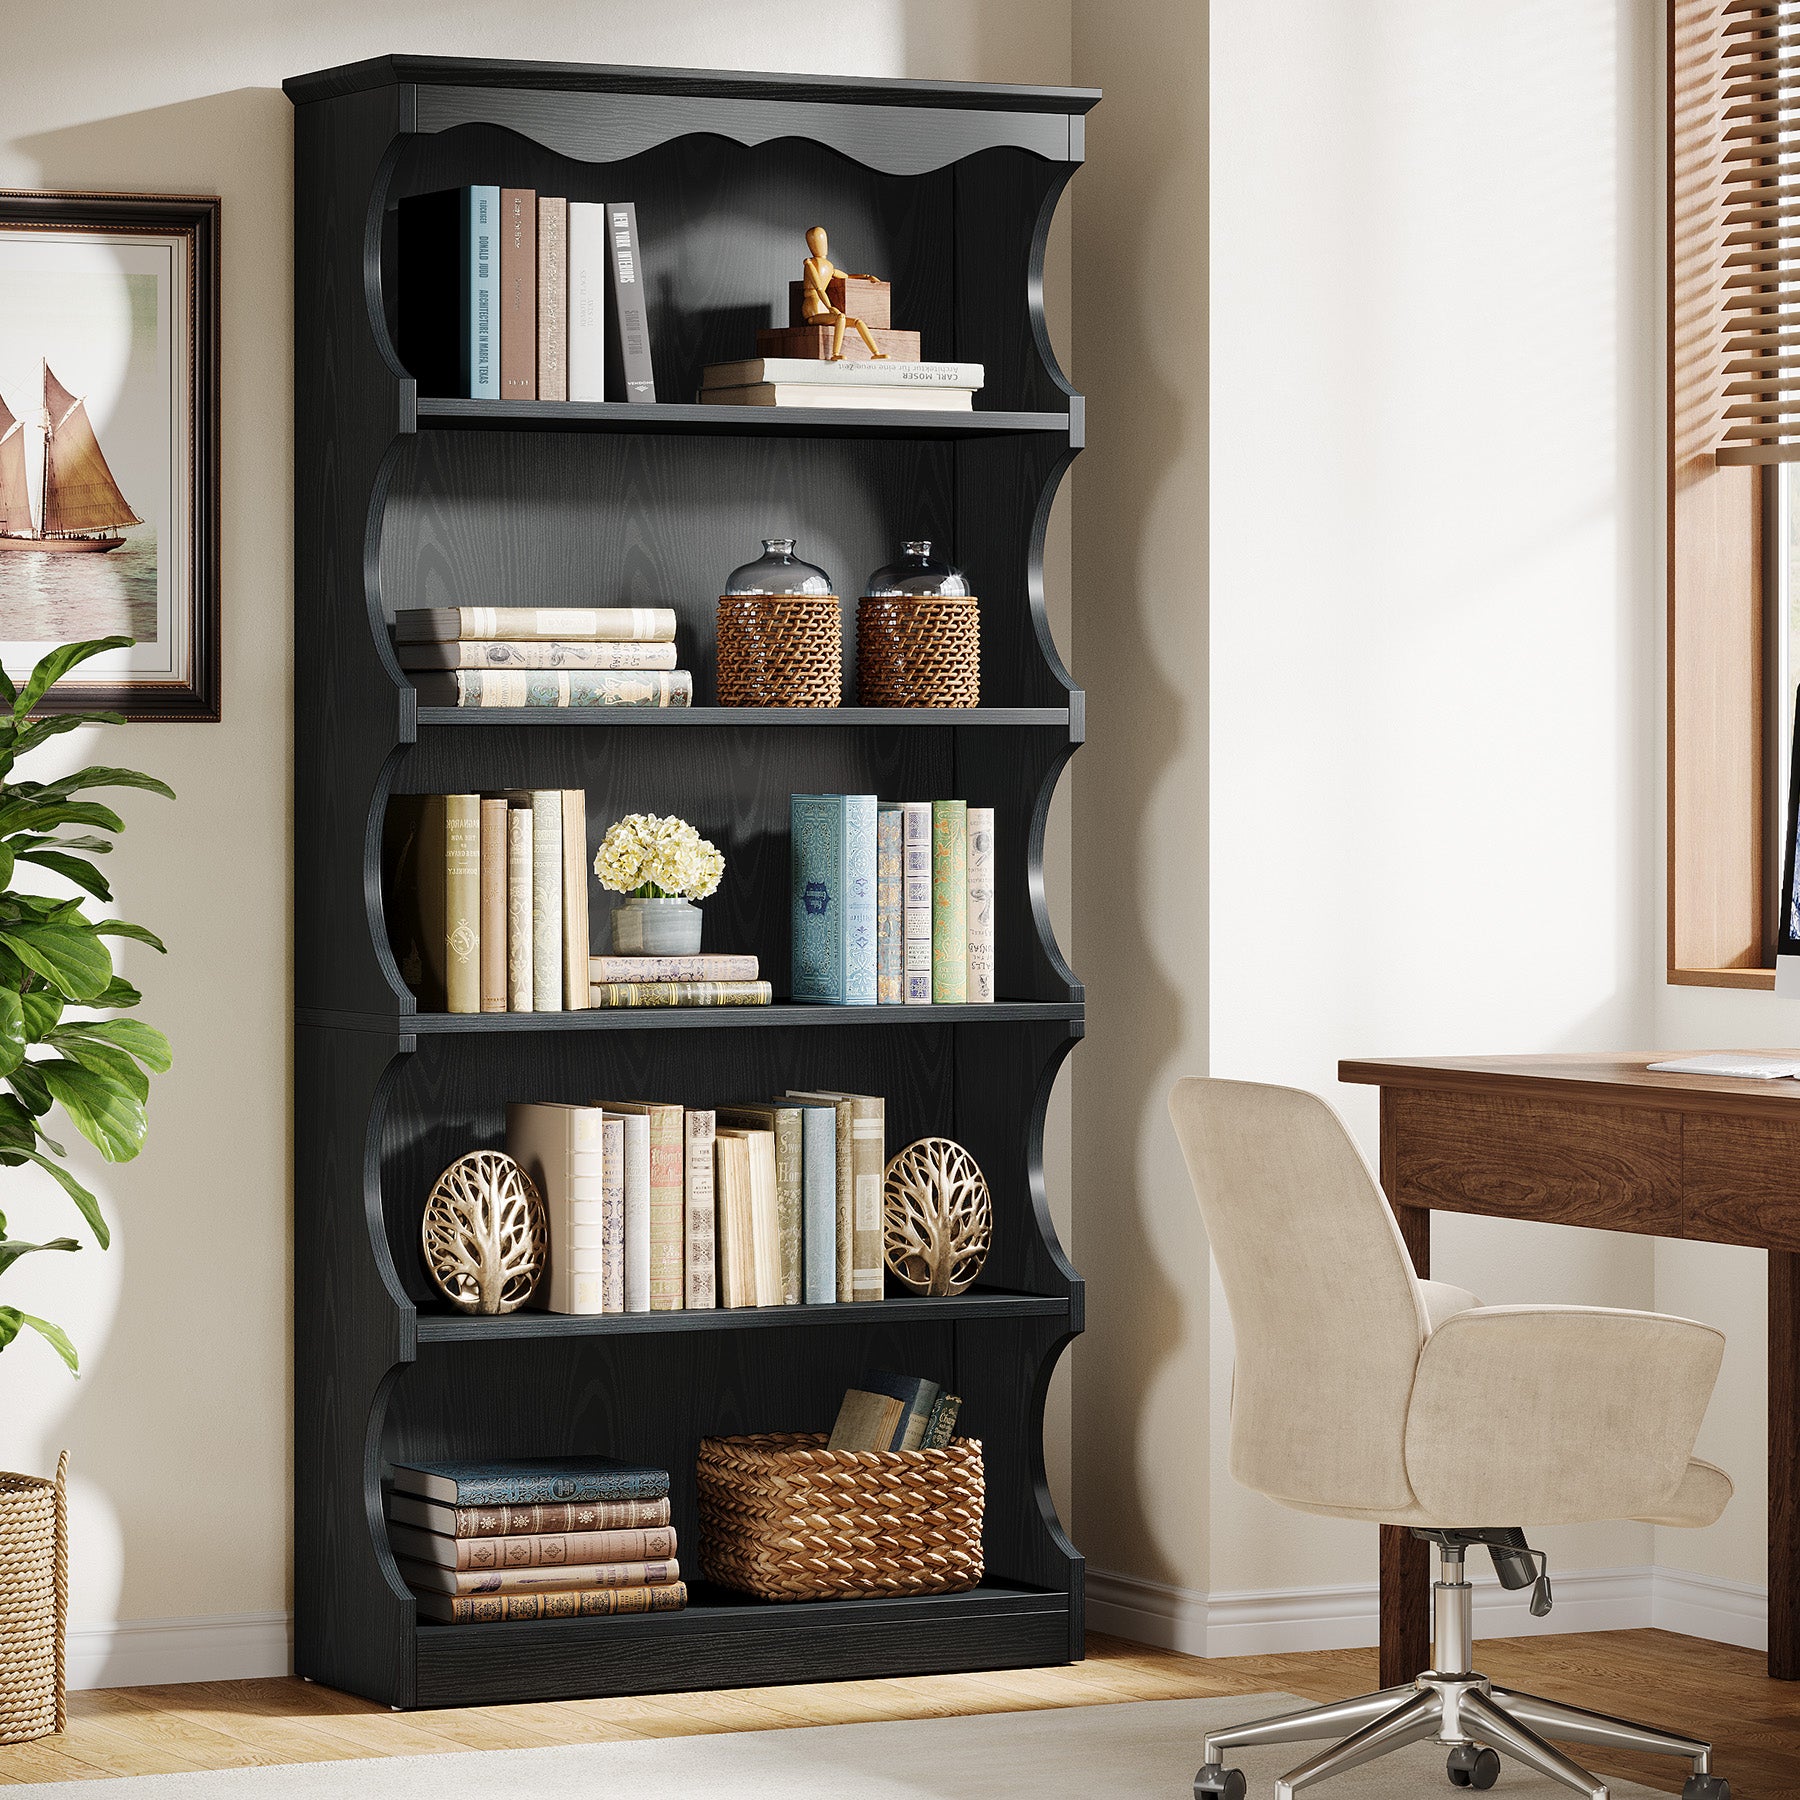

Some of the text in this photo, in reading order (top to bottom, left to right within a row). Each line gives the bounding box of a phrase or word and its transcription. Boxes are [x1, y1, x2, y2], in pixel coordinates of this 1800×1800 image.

[613, 212, 635, 284] NEW YORK INTERIORS
[478, 235, 489, 278] DONALD JUDD
[478, 289, 489, 334] ARCHITECTURE
[838, 363, 855, 371] Zeit
[878, 364, 897, 372] eine
[912, 365, 959, 374] Architektur
[478, 365, 489, 385] TEXAS
[902, 372, 959, 381] CARL MOSER
